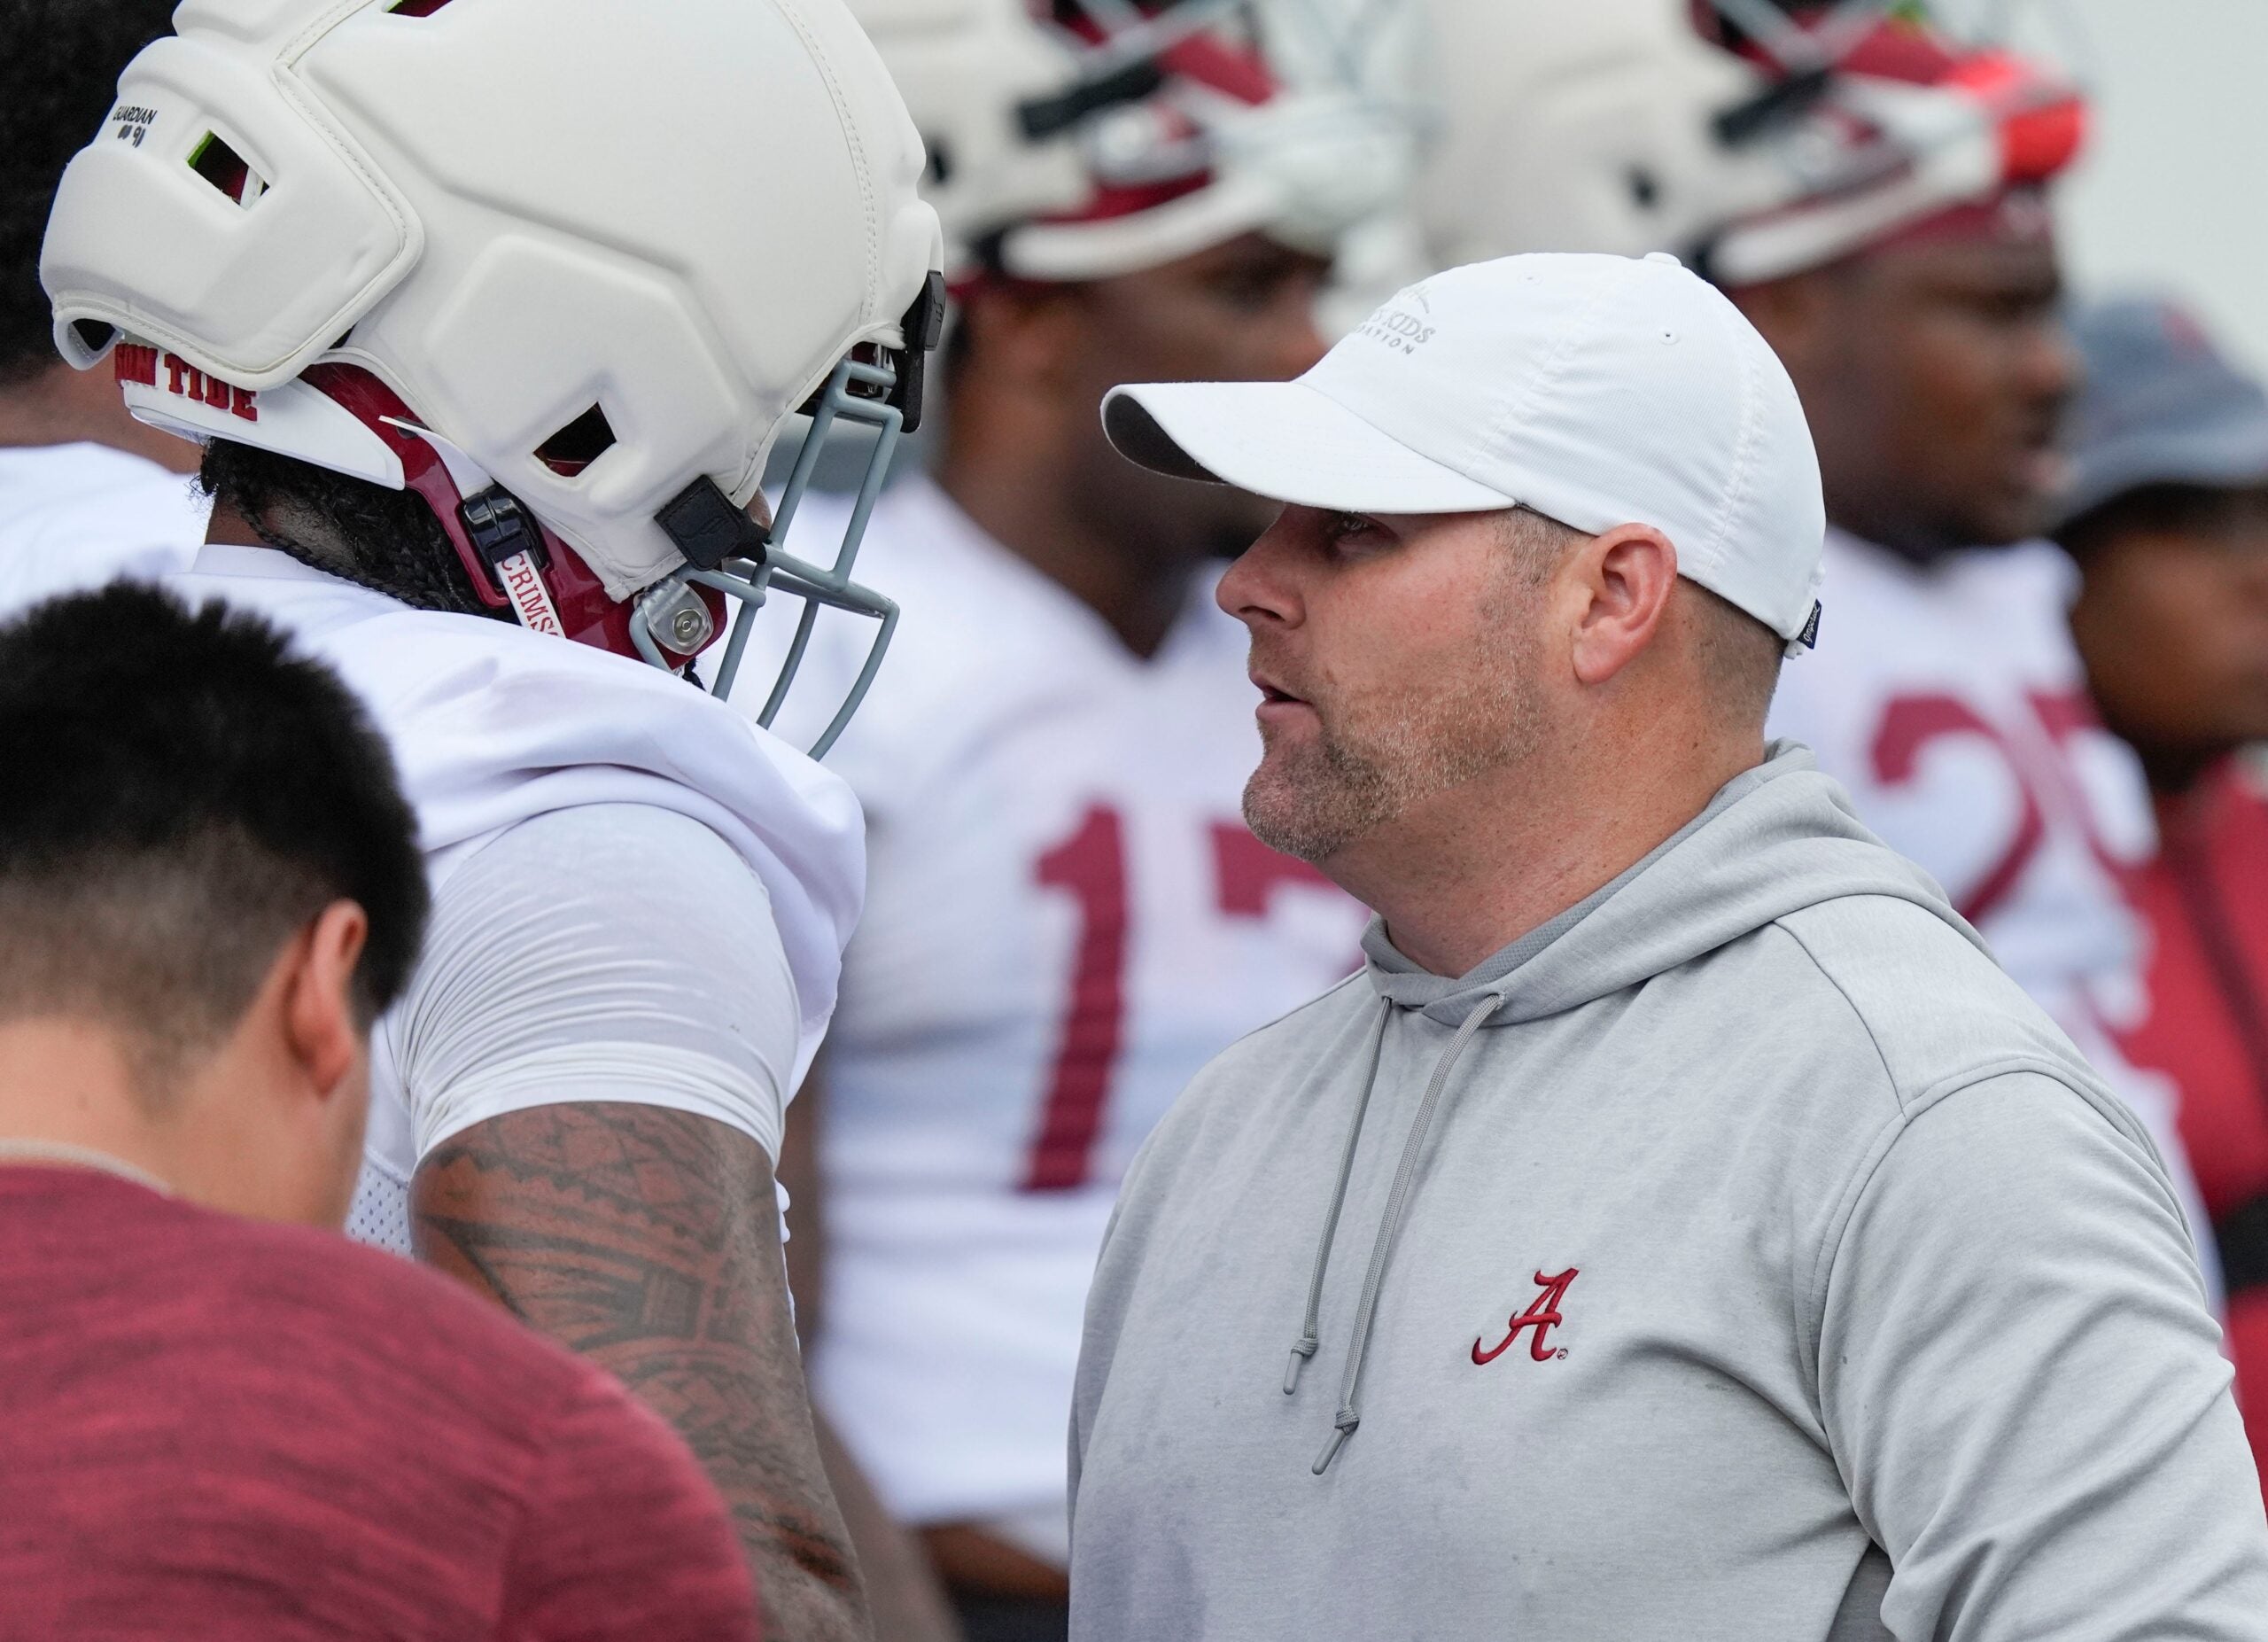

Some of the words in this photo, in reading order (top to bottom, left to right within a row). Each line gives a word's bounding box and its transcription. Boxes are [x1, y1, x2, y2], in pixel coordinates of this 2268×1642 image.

[164, 353, 258, 422] TIDE
[501, 552, 559, 636] CRIMS
[1472, 1267, 1580, 1366] A
